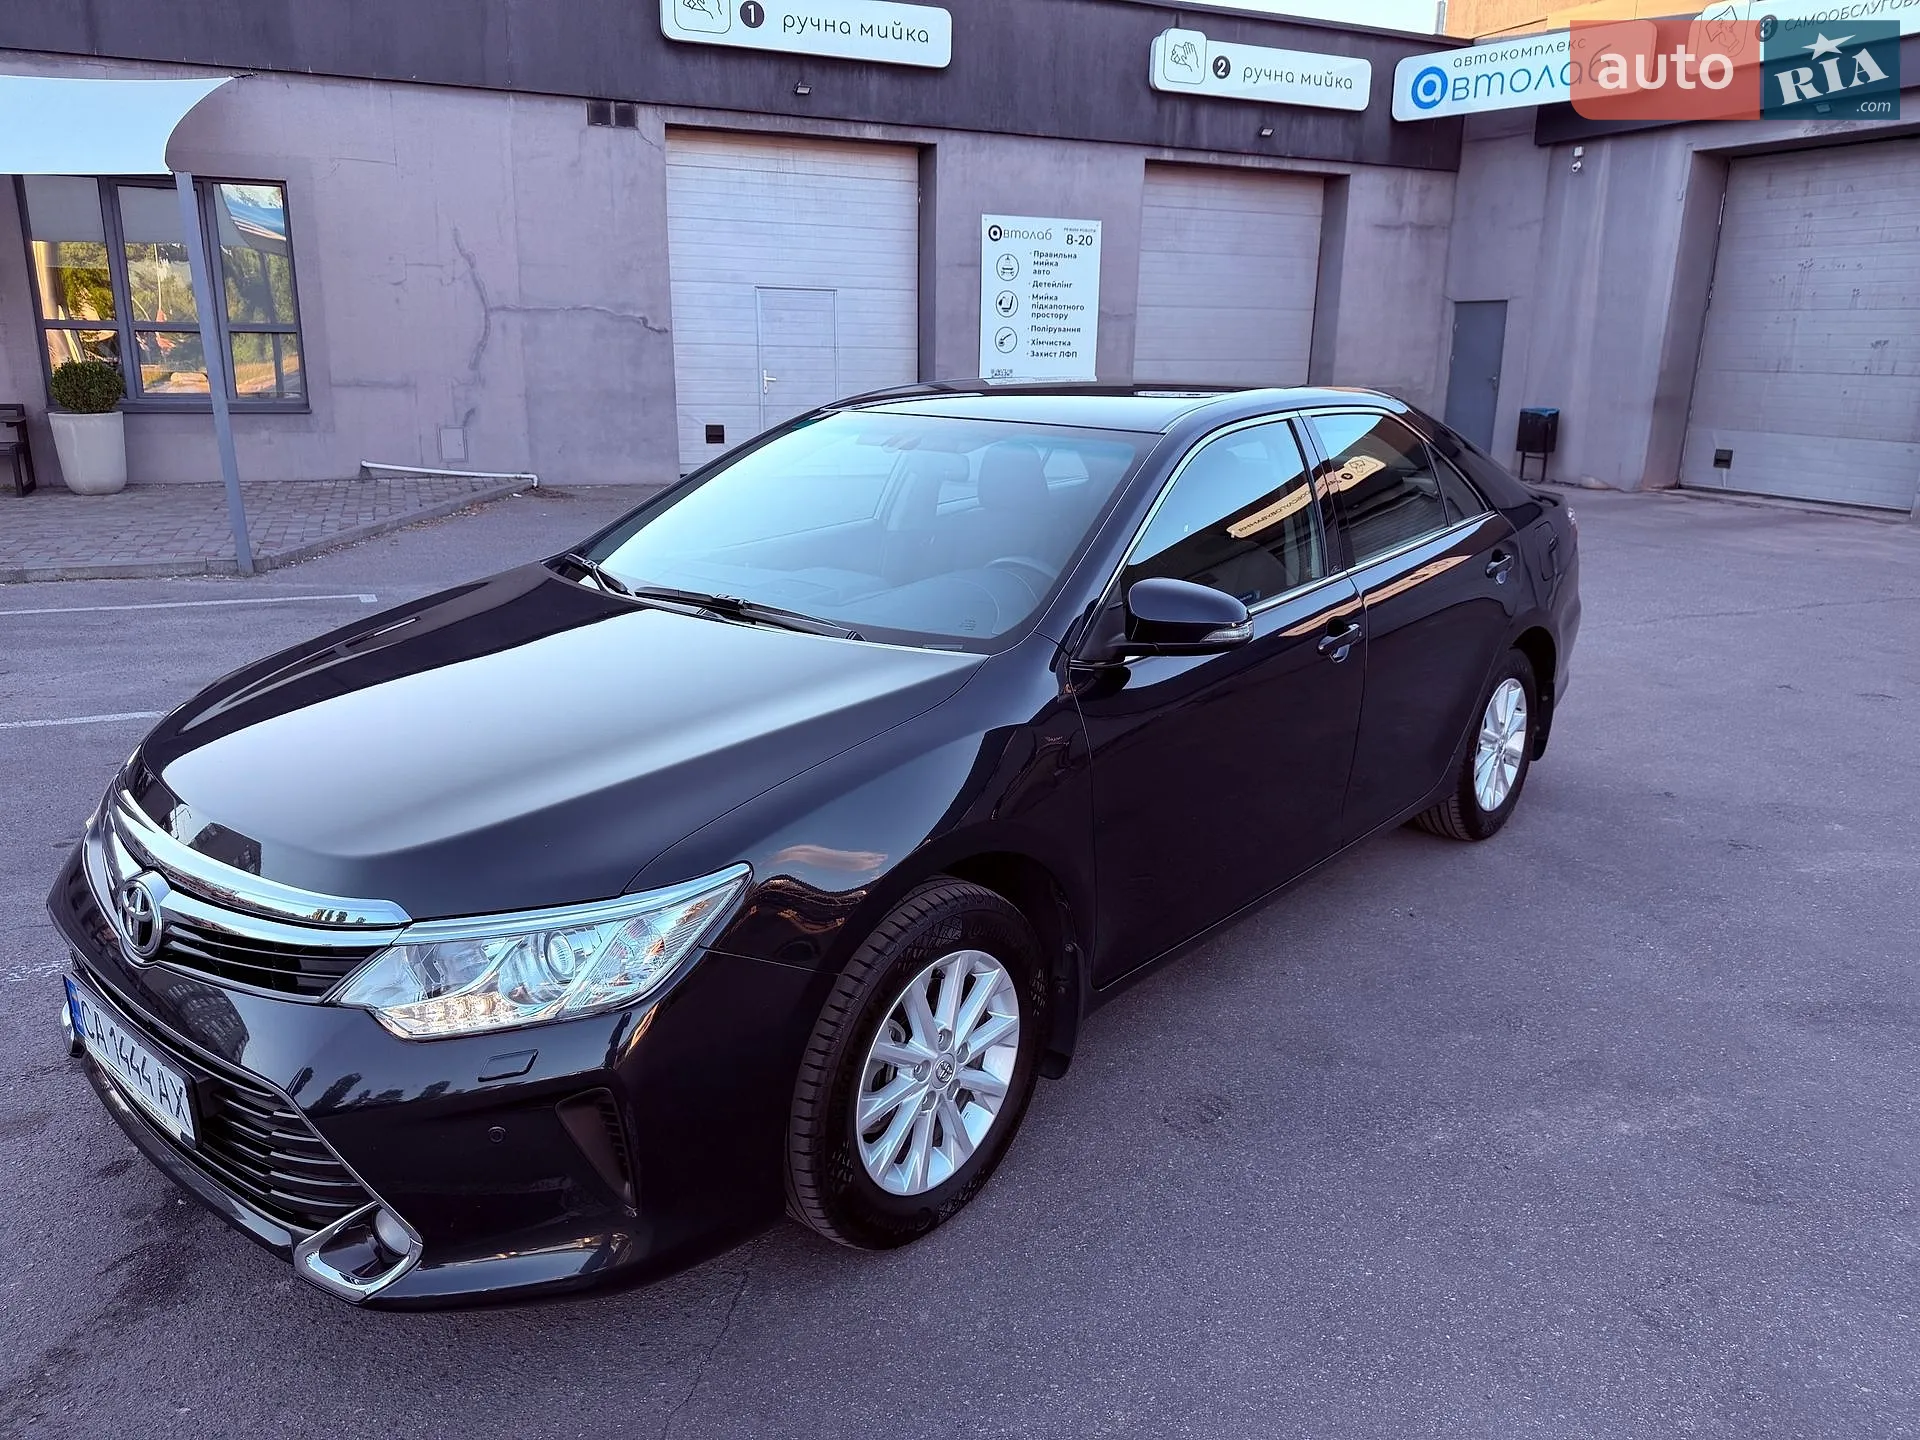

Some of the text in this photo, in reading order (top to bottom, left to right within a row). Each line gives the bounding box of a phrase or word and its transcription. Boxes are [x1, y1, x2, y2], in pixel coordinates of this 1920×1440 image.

[747, 4, 930, 44] 1 ручна мийка
[1453, 38, 1587, 68] автокомплекс
[1217, 59, 1353, 90] 2 ручна мийка
[1066, 233, 1093, 246] 8-20
[1033, 250, 1078, 260] Правильна
[1033, 259, 1059, 267] мийка
[1031, 280, 1073, 289] Детейлінг
[1031, 293, 1058, 301] Мийка
[1031, 302, 1085, 311] підкапотного
[1031, 311, 1069, 320] простору
[1030, 325, 1081, 334] Полірування
[1030, 338, 1071, 347] Хімчистка
[1059, 350, 1078, 359] ЛФП
[81, 1000, 109, 1055] CA
[109, 1026, 155, 1098] 1444
[157, 1066, 191, 1129] AX
